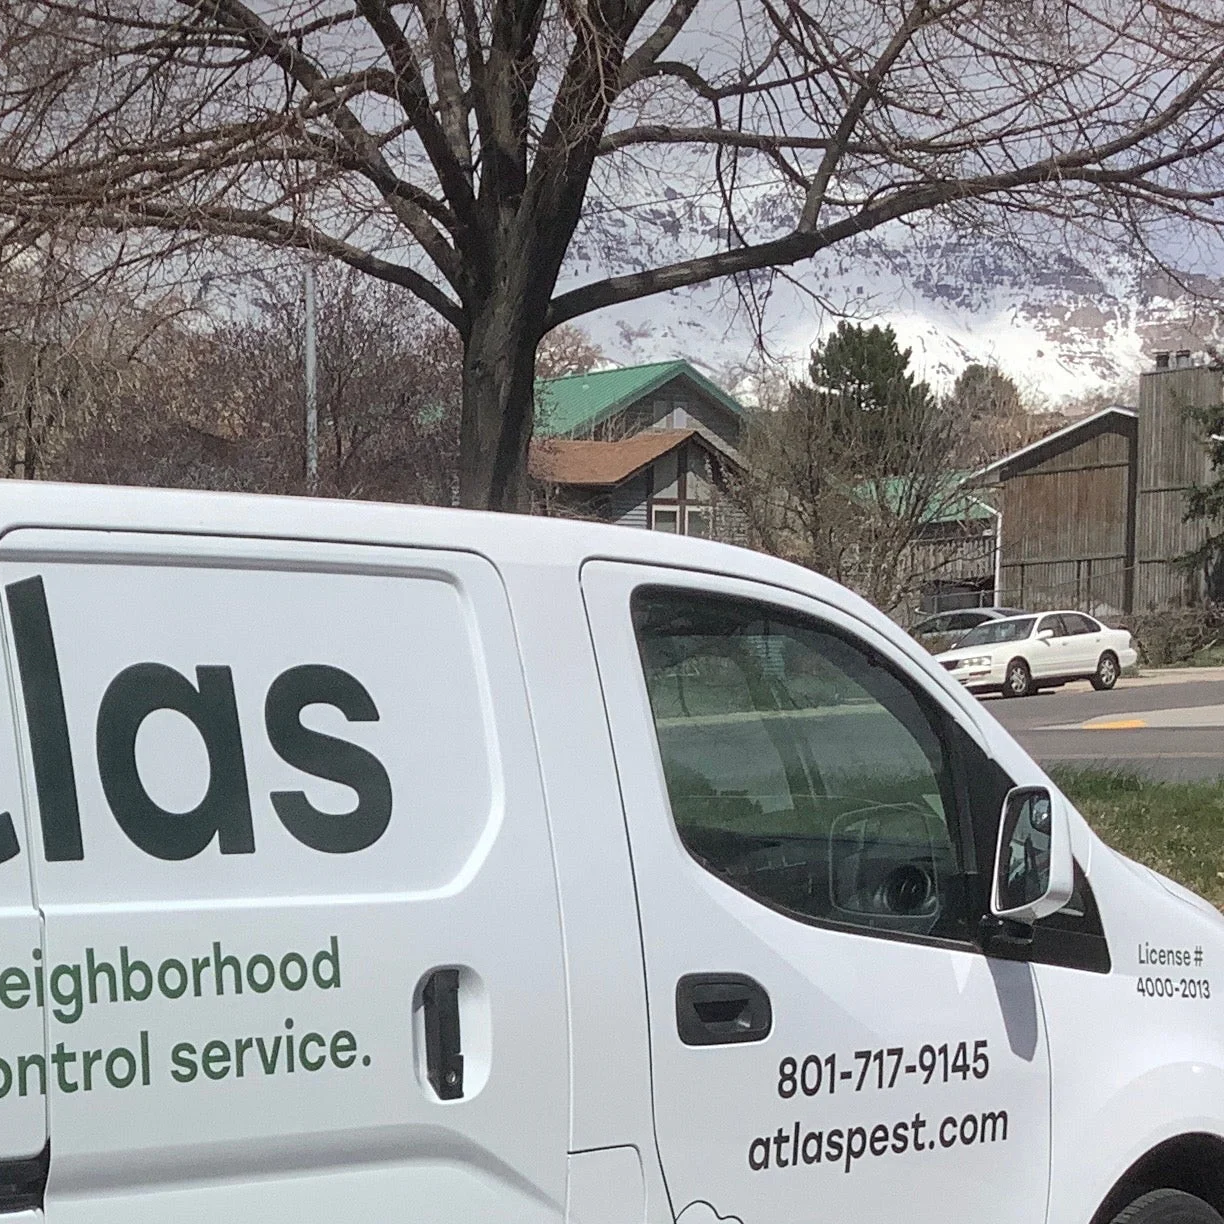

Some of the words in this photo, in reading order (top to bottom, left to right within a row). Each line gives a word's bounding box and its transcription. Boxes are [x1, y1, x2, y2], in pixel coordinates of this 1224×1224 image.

[1137, 941, 1192, 967] License
[1193, 945, 1204, 968] #
[1136, 976, 1211, 1000] 4000-2013
[170, 1017, 373, 1084] service.
[777, 1038, 990, 1099] 801-717-9145
[747, 1109, 1009, 1174] atlaspest.com
